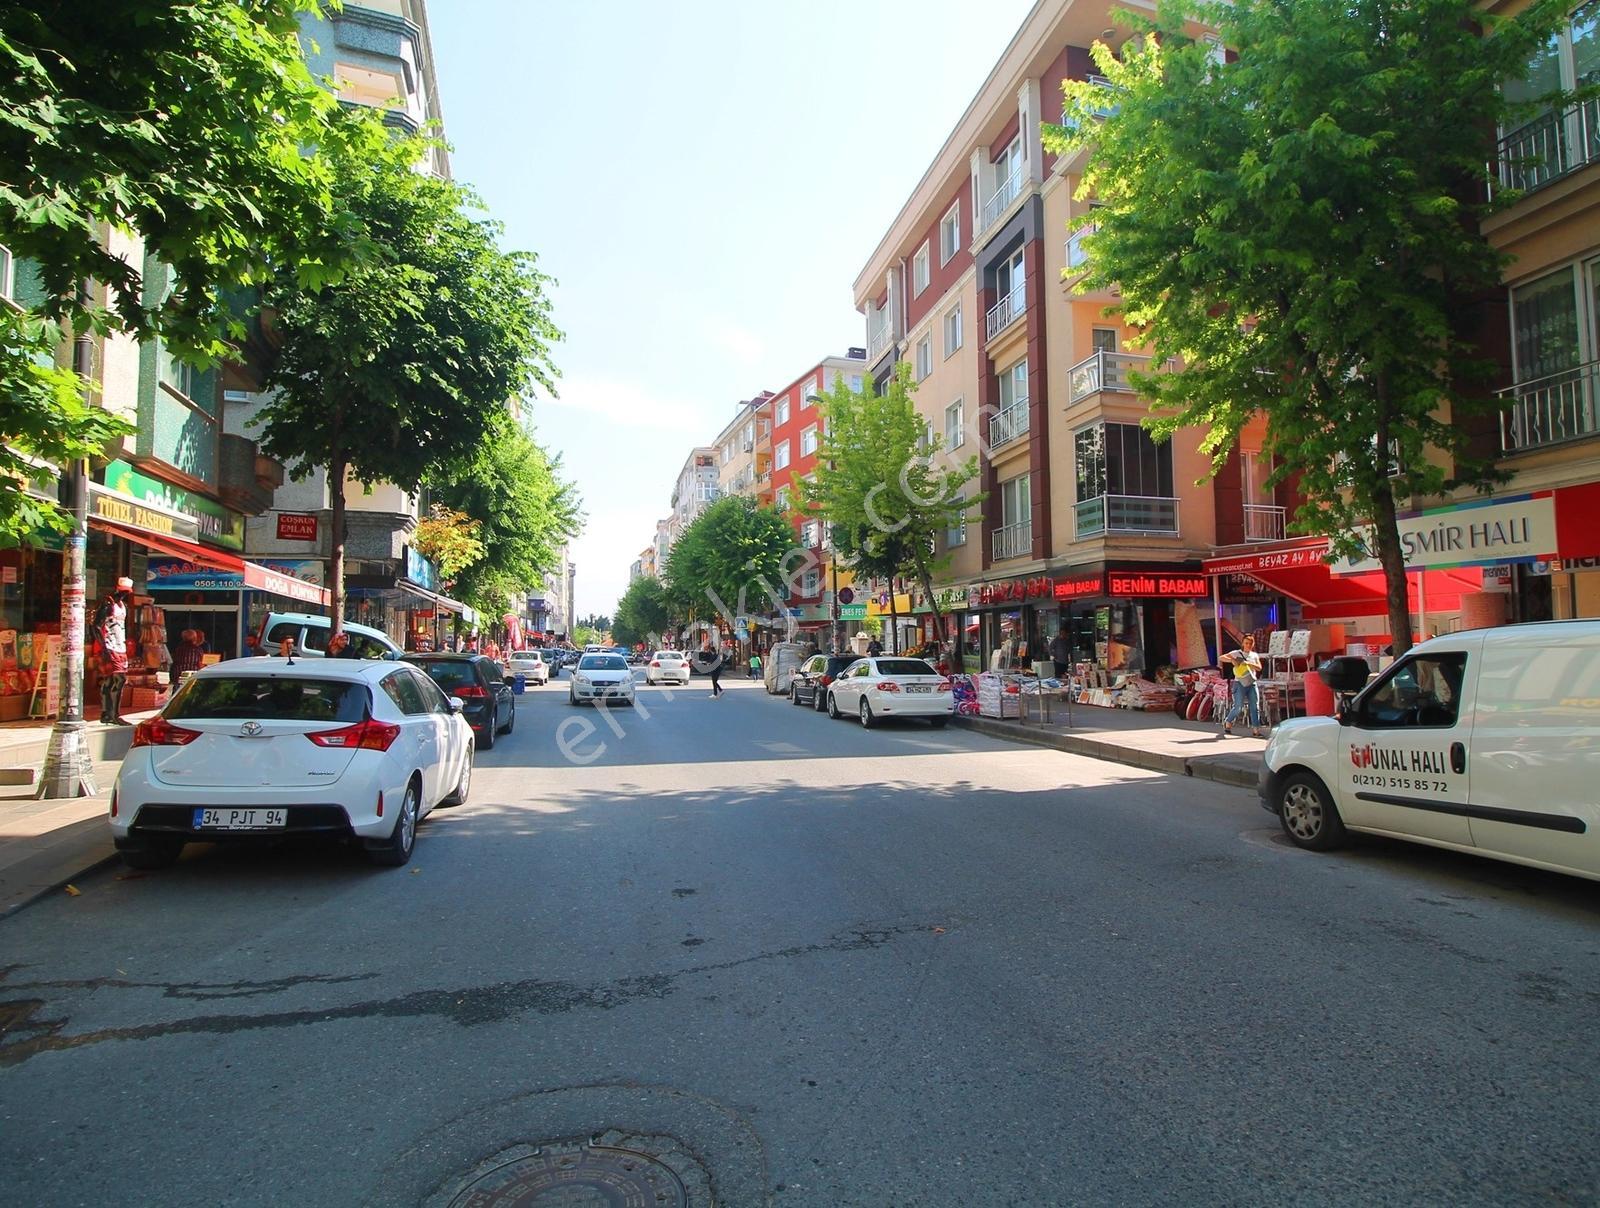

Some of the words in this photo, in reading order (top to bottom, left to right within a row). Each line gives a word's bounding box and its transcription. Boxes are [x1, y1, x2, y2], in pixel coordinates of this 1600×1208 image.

[97, 496, 133, 524] TÜNEL
[135, 505, 173, 535] FASHION
[280, 525, 313, 534] EMLAK
[1401, 522, 1463, 556] ŞMİR
[1470, 517, 1529, 548] HALI
[1259, 554, 1288, 567] BEYAZ
[1291, 552, 1304, 564] AY
[265, 576, 288, 594] DOĞA
[1055, 581, 1075, 595] BENİM
[1076, 580, 1100, 593] BABAM
[1112, 576, 1154, 593] BENİM
[1159, 579, 1205, 593] BABAM
[1371, 742, 1408, 771] ÜNAL
[1411, 750, 1446, 774] HALI
[1352, 774, 1386, 788] 0(212)
[1390, 778, 1411, 789] 515
[1414, 780, 1429, 791] 85
[1432, 781, 1448, 792] 72
[203, 811, 219, 824] 34
[230, 811, 256, 824] PJT
[266, 811, 282, 824] 94
